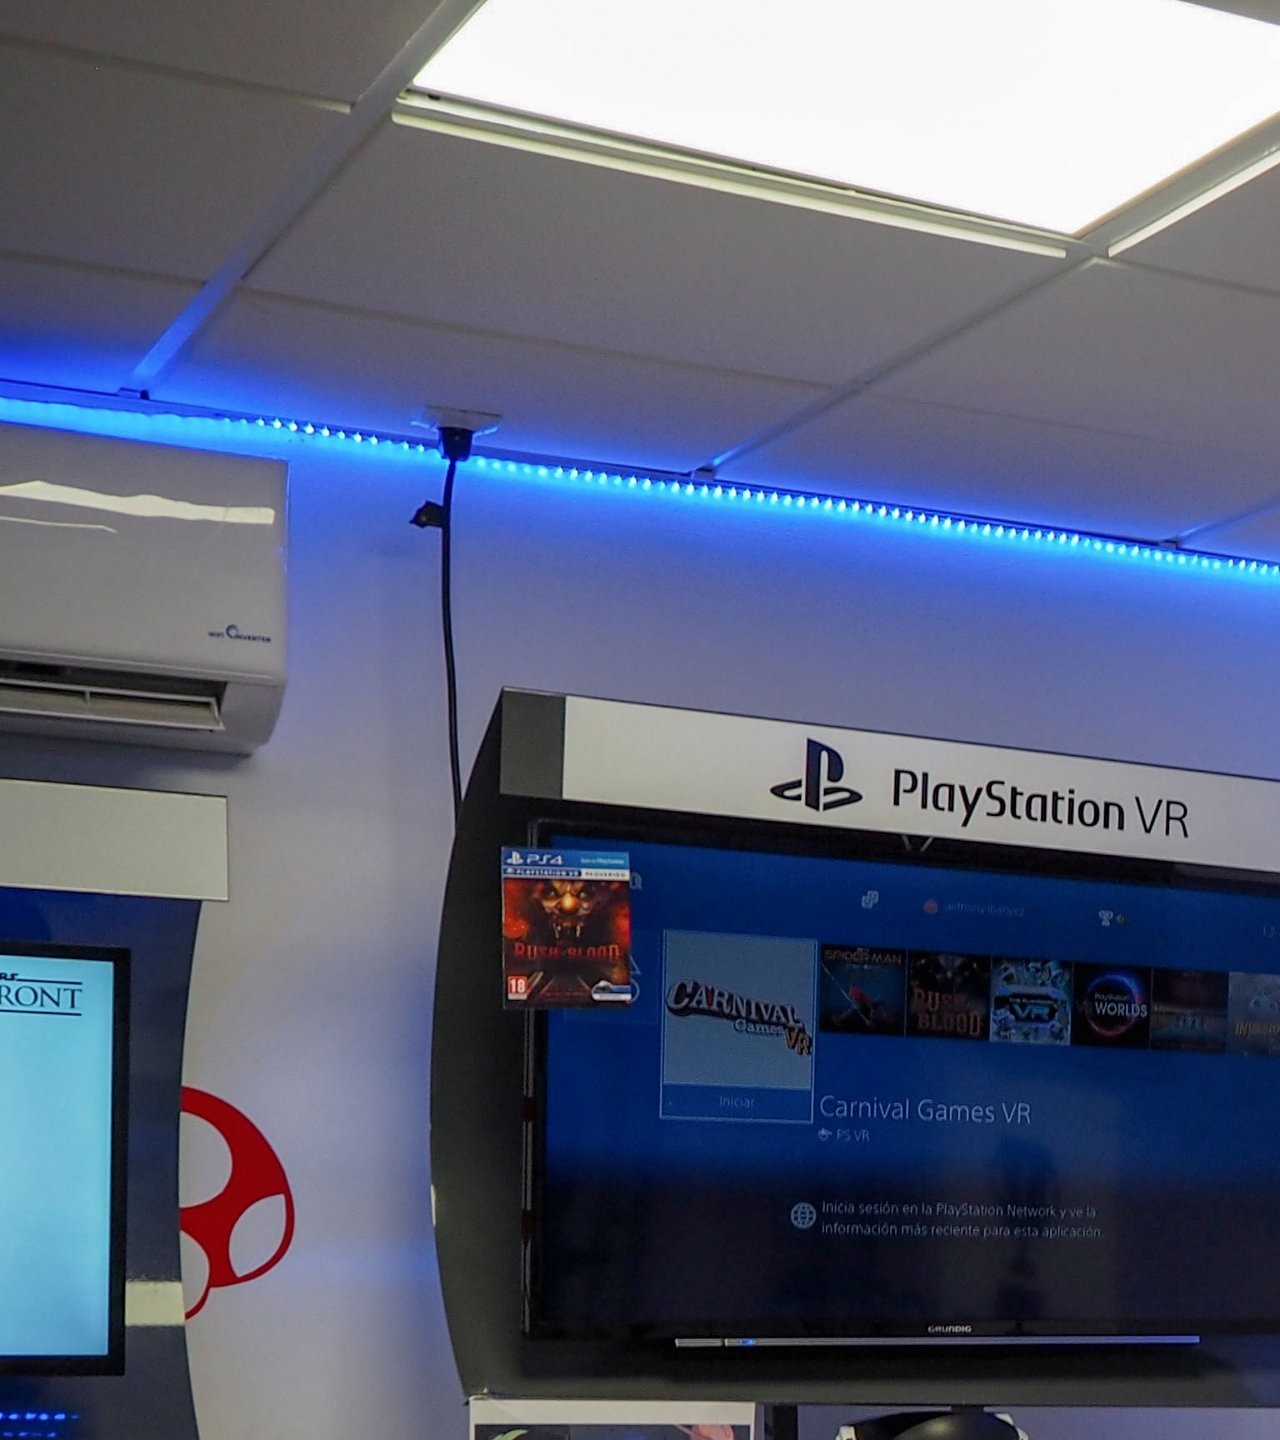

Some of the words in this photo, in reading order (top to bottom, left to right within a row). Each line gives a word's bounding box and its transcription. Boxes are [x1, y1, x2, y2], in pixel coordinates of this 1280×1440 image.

[892, 767, 1126, 829] PlayStation
[1134, 795, 1190, 838] VR
[527, 854, 564, 866] PS4
[509, 978, 526, 993] 18
[0, 984, 83, 1009] RONT
[667, 979, 803, 1028] CARNIVAL
[1095, 1002, 1148, 1018] WORLDS
[734, 1018, 785, 1035] Games
[784, 1026, 812, 1055] VR
[719, 1095, 755, 1109] Iniciar
[820, 1095, 910, 1120] Carnival
[917, 1099, 995, 1124] Games
[1001, 1102, 1031, 1124] VR
[836, 1129, 850, 1141] PS
[853, 1129, 870, 1142] VR
[821, 1201, 855, 1214] Inicia
[859, 1201, 899, 1215] sesión
[902, 1205, 918, 1215] en
[921, 1203, 932, 1216] la
[936, 1203, 1004, 1219] PlayStation
[1007, 1205, 1056, 1218] Network
[1059, 1208, 1067, 1219] y
[1070, 1208, 1083, 1218] ve
[1086, 1206, 1096, 1218] la
[821, 1221, 898, 1236] información
[901, 1222, 928, 1236] más
[931, 1223, 980, 1237] reciente
[983, 1226, 1011, 1239] para
[1014, 1225, 1039, 1237] esta
[927, 1325, 973, 1334] GRUNDIG
